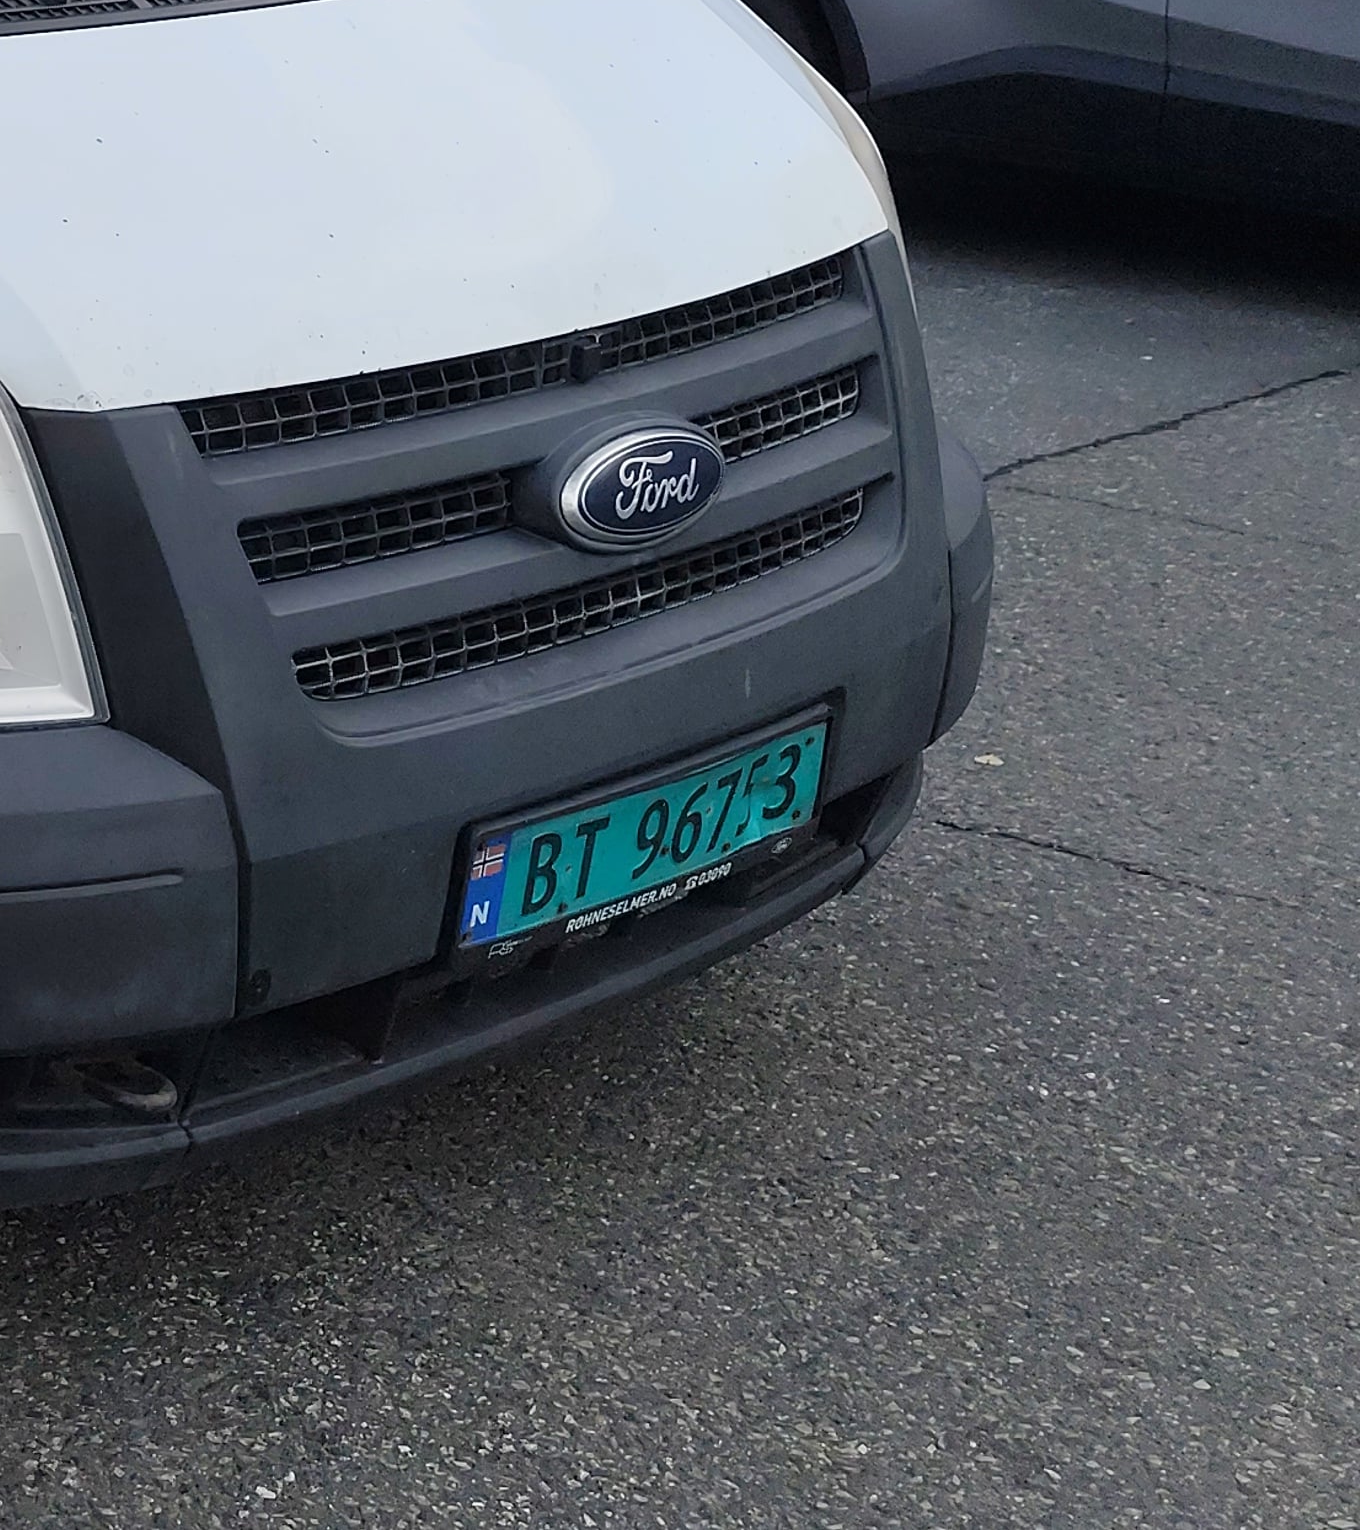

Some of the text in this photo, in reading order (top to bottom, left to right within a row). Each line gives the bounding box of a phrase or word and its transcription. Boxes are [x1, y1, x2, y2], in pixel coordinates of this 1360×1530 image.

[615, 450, 700, 520] Ford
[519, 743, 802, 917] BT 96753
[469, 900, 490, 927] N
